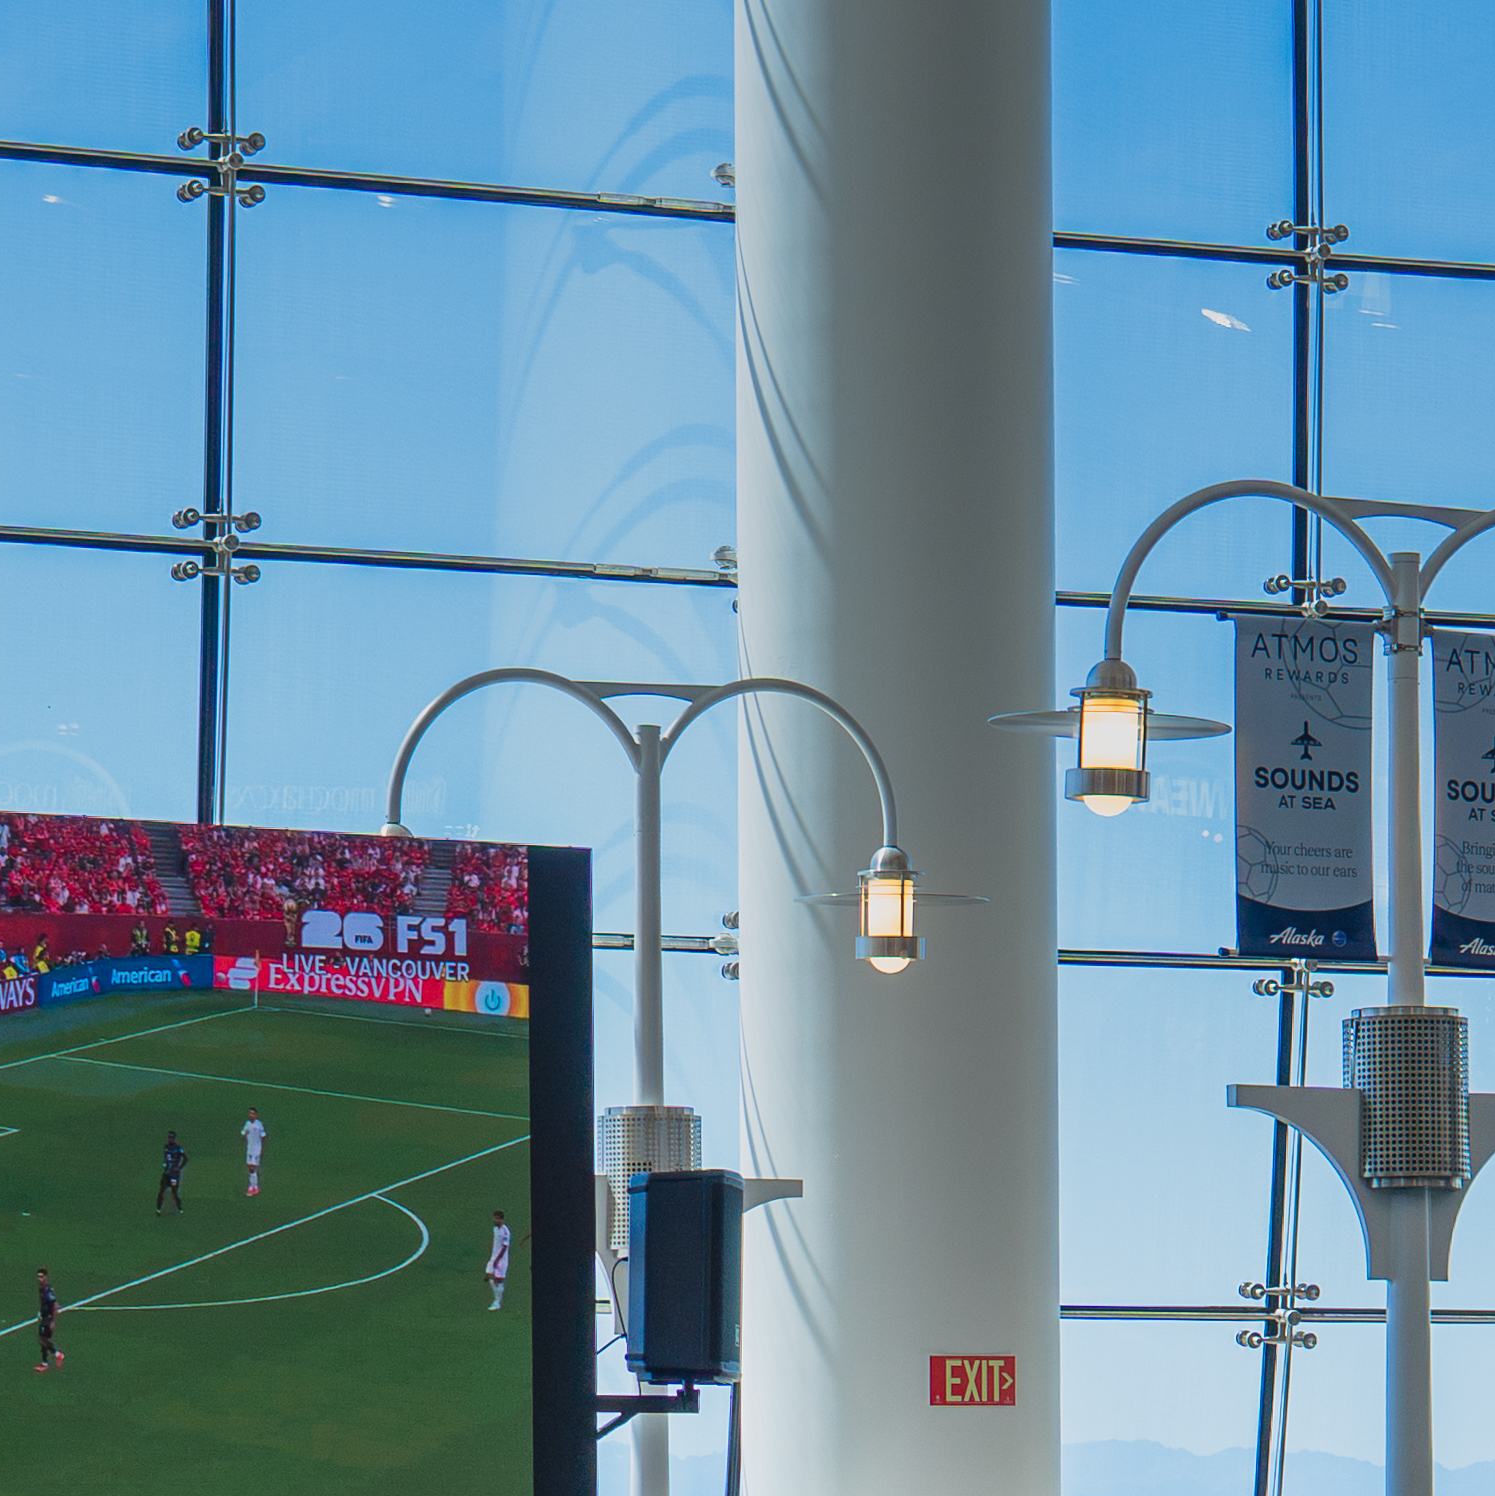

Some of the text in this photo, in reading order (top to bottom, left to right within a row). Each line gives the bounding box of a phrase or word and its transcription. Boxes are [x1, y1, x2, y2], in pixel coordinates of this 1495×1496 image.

[1250, 632, 1358, 664] ATMOS
[1265, 667, 1350, 685] REWARDS
[1255, 766, 1360, 793] SOUNDS
[1278, 794, 1336, 811] AT SEA
[1468, 808, 1486, 821] AT
[1265, 840, 1354, 859] Your cheers are
[1261, 861, 1358, 878] music to our ears
[1457, 859, 1475, 874] the
[1461, 878, 1472, 892] of
[301, 909, 384, 951] 26
[354, 934, 374, 945] FIFA
[397, 914, 468, 957] FS1
[1270, 926, 1325, 948] Alaska
[111, 968, 172, 985] American
[282, 953, 327, 975] LIVE
[346, 956, 470, 982] VANCOUVER
[51, 976, 89, 998] American
[268, 963, 423, 1003] ExpressVPN
[946, 1359, 1005, 1402] EXIT
